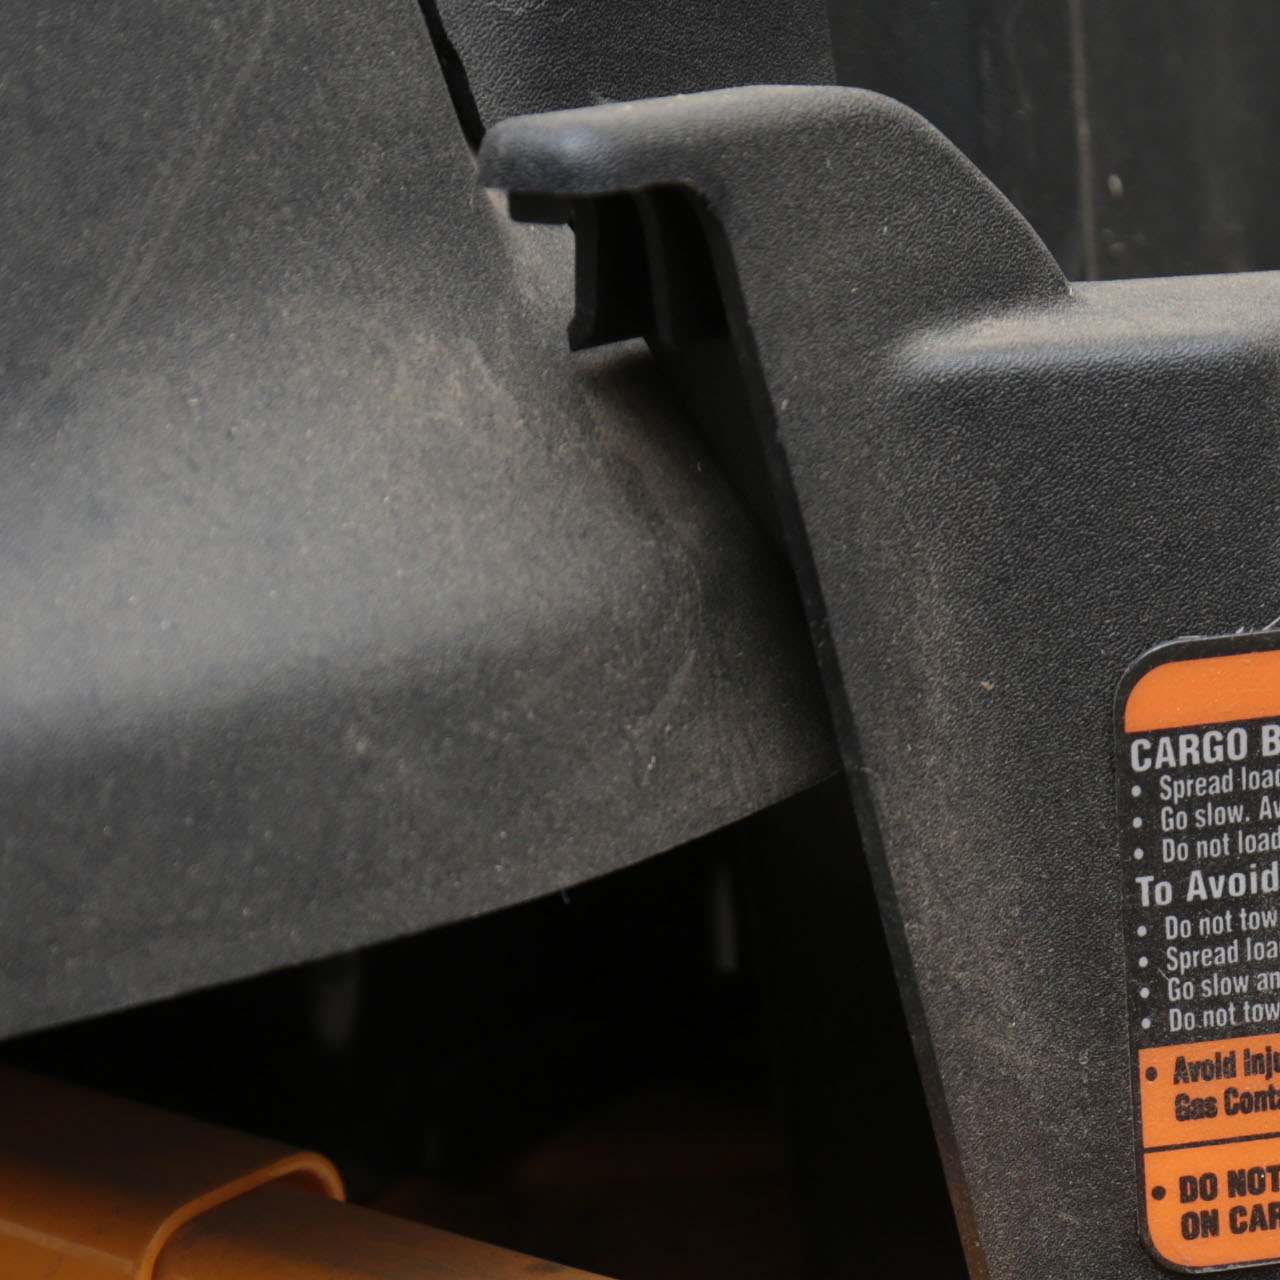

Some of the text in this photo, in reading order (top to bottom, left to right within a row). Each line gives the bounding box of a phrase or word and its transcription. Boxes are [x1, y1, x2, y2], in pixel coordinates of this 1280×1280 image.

[1130, 727, 1248, 772] CARGO
[1159, 767, 1234, 804] Spread
[1160, 805, 1188, 832] Go
[1194, 801, 1250, 828] slow.
[1162, 838, 1189, 863] Do
[1196, 832, 1230, 859] not
[1135, 875, 1173, 907] To
[1186, 860, 1279, 902] Avoid
[1164, 915, 1192, 940] Do
[1198, 910, 1233, 936] not
[1239, 907, 1278, 931] tow
[1166, 941, 1240, 975] Spread
[1165, 976, 1195, 1002] Go
[1200, 972, 1249, 998] slow
[1169, 1008, 1196, 1033] Do
[1198, 1001, 1237, 1028] not
[1243, 1000, 1280, 1023] tow
[1173, 1050, 1237, 1085] Avoid
[1174, 1093, 1218, 1122] Gas
[1178, 1172, 1218, 1204] DO
[1180, 1209, 1220, 1241] ON
